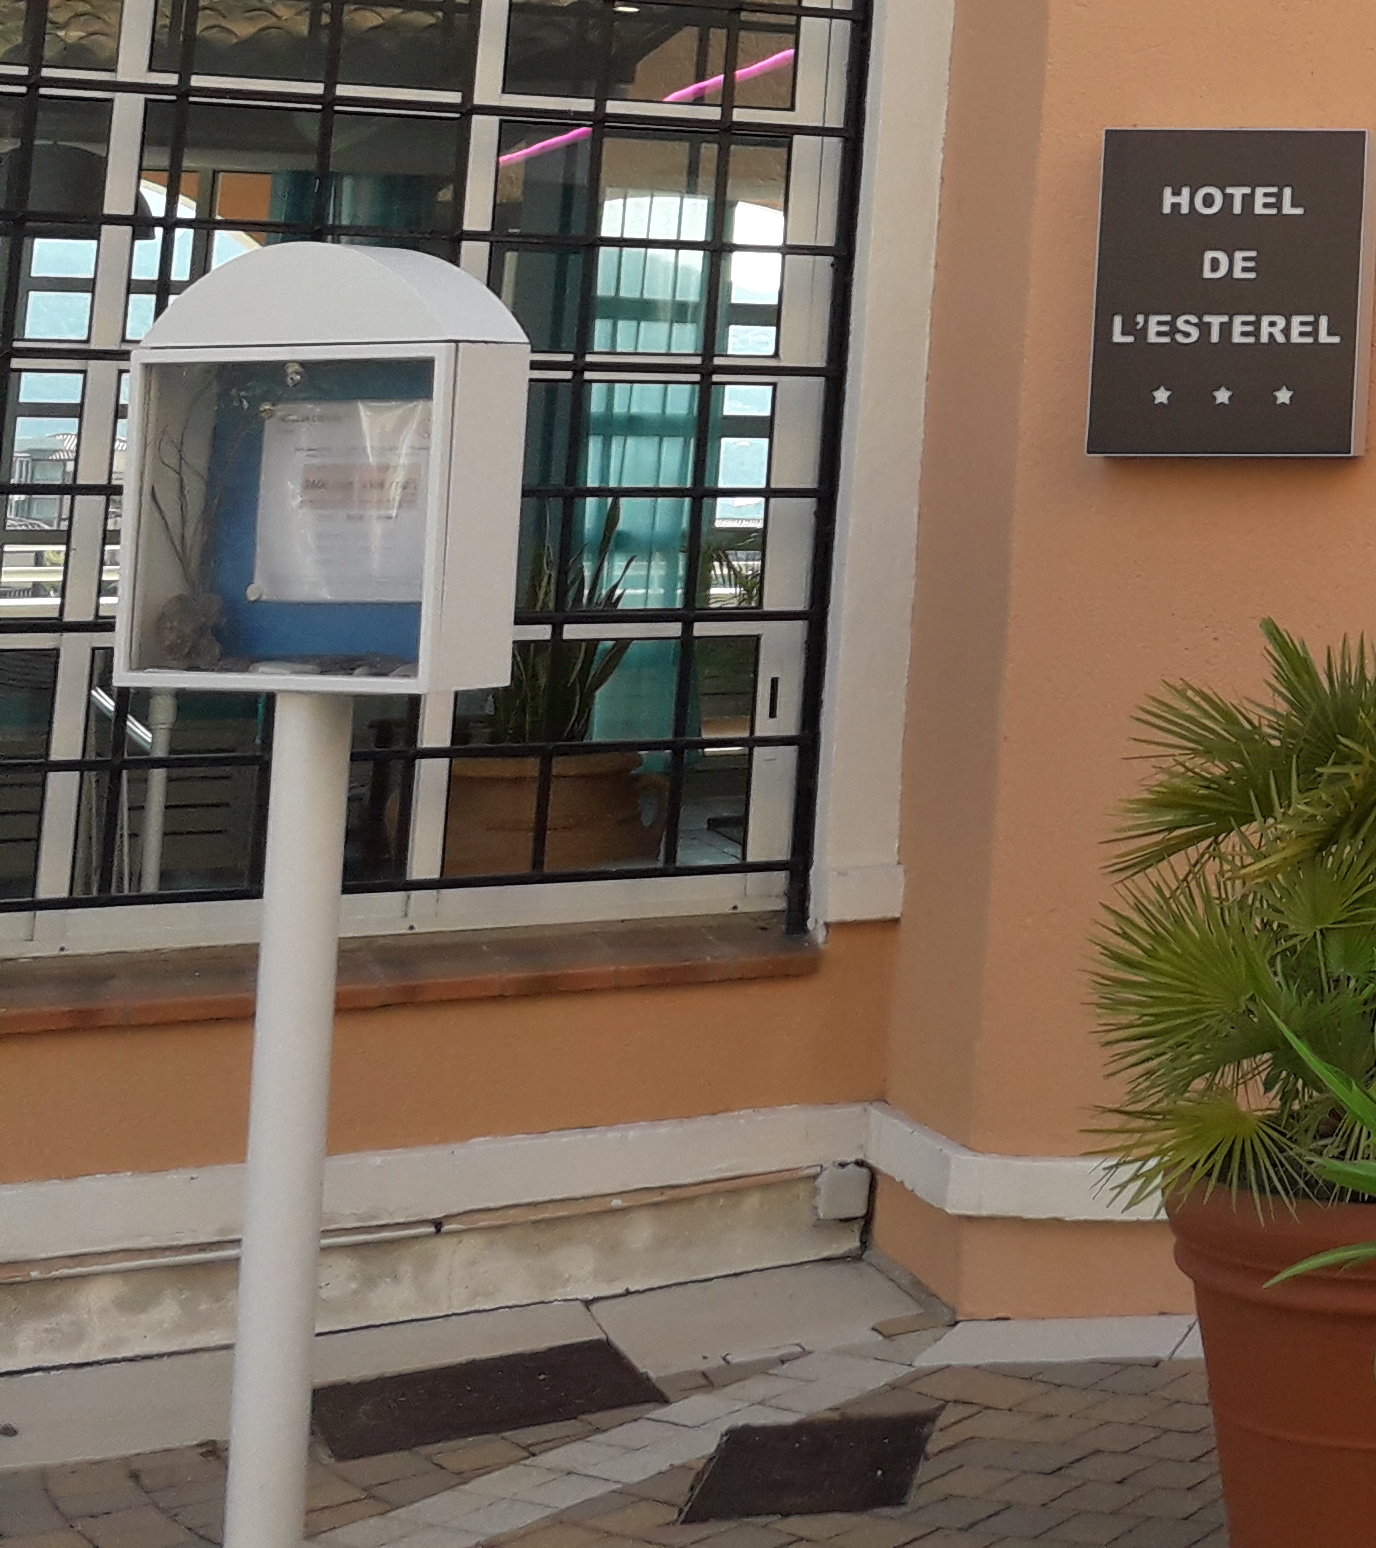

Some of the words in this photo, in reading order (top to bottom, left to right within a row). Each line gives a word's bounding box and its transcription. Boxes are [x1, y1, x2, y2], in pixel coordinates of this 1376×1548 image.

[1161, 185, 1305, 215] HOTEL
[1202, 250, 1258, 279] DE
[1111, 313, 1342, 344] L'ESTEREL
